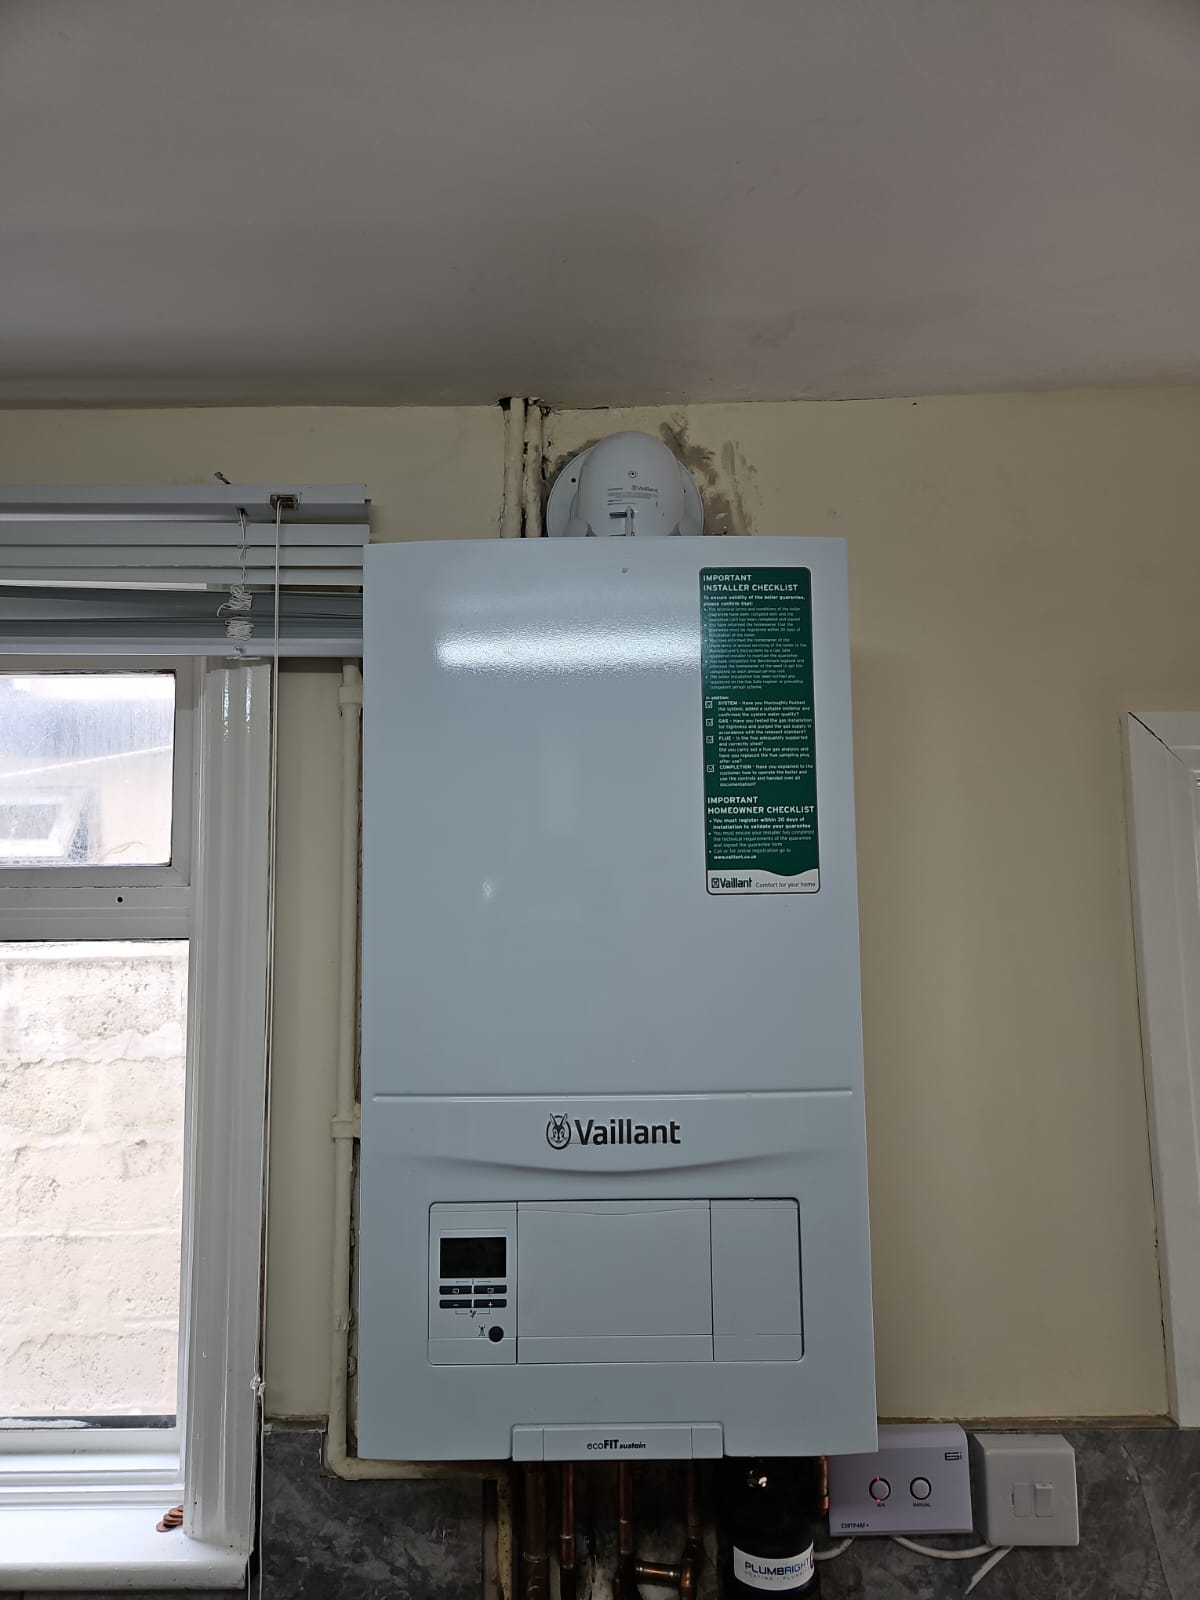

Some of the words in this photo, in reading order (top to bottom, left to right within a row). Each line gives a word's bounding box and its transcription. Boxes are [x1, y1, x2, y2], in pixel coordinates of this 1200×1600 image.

[720, 878, 752, 888] Vaillant
[574, 1119, 681, 1145] Vaillant
[744, 1557, 810, 1576] PLUMBRIGHT
